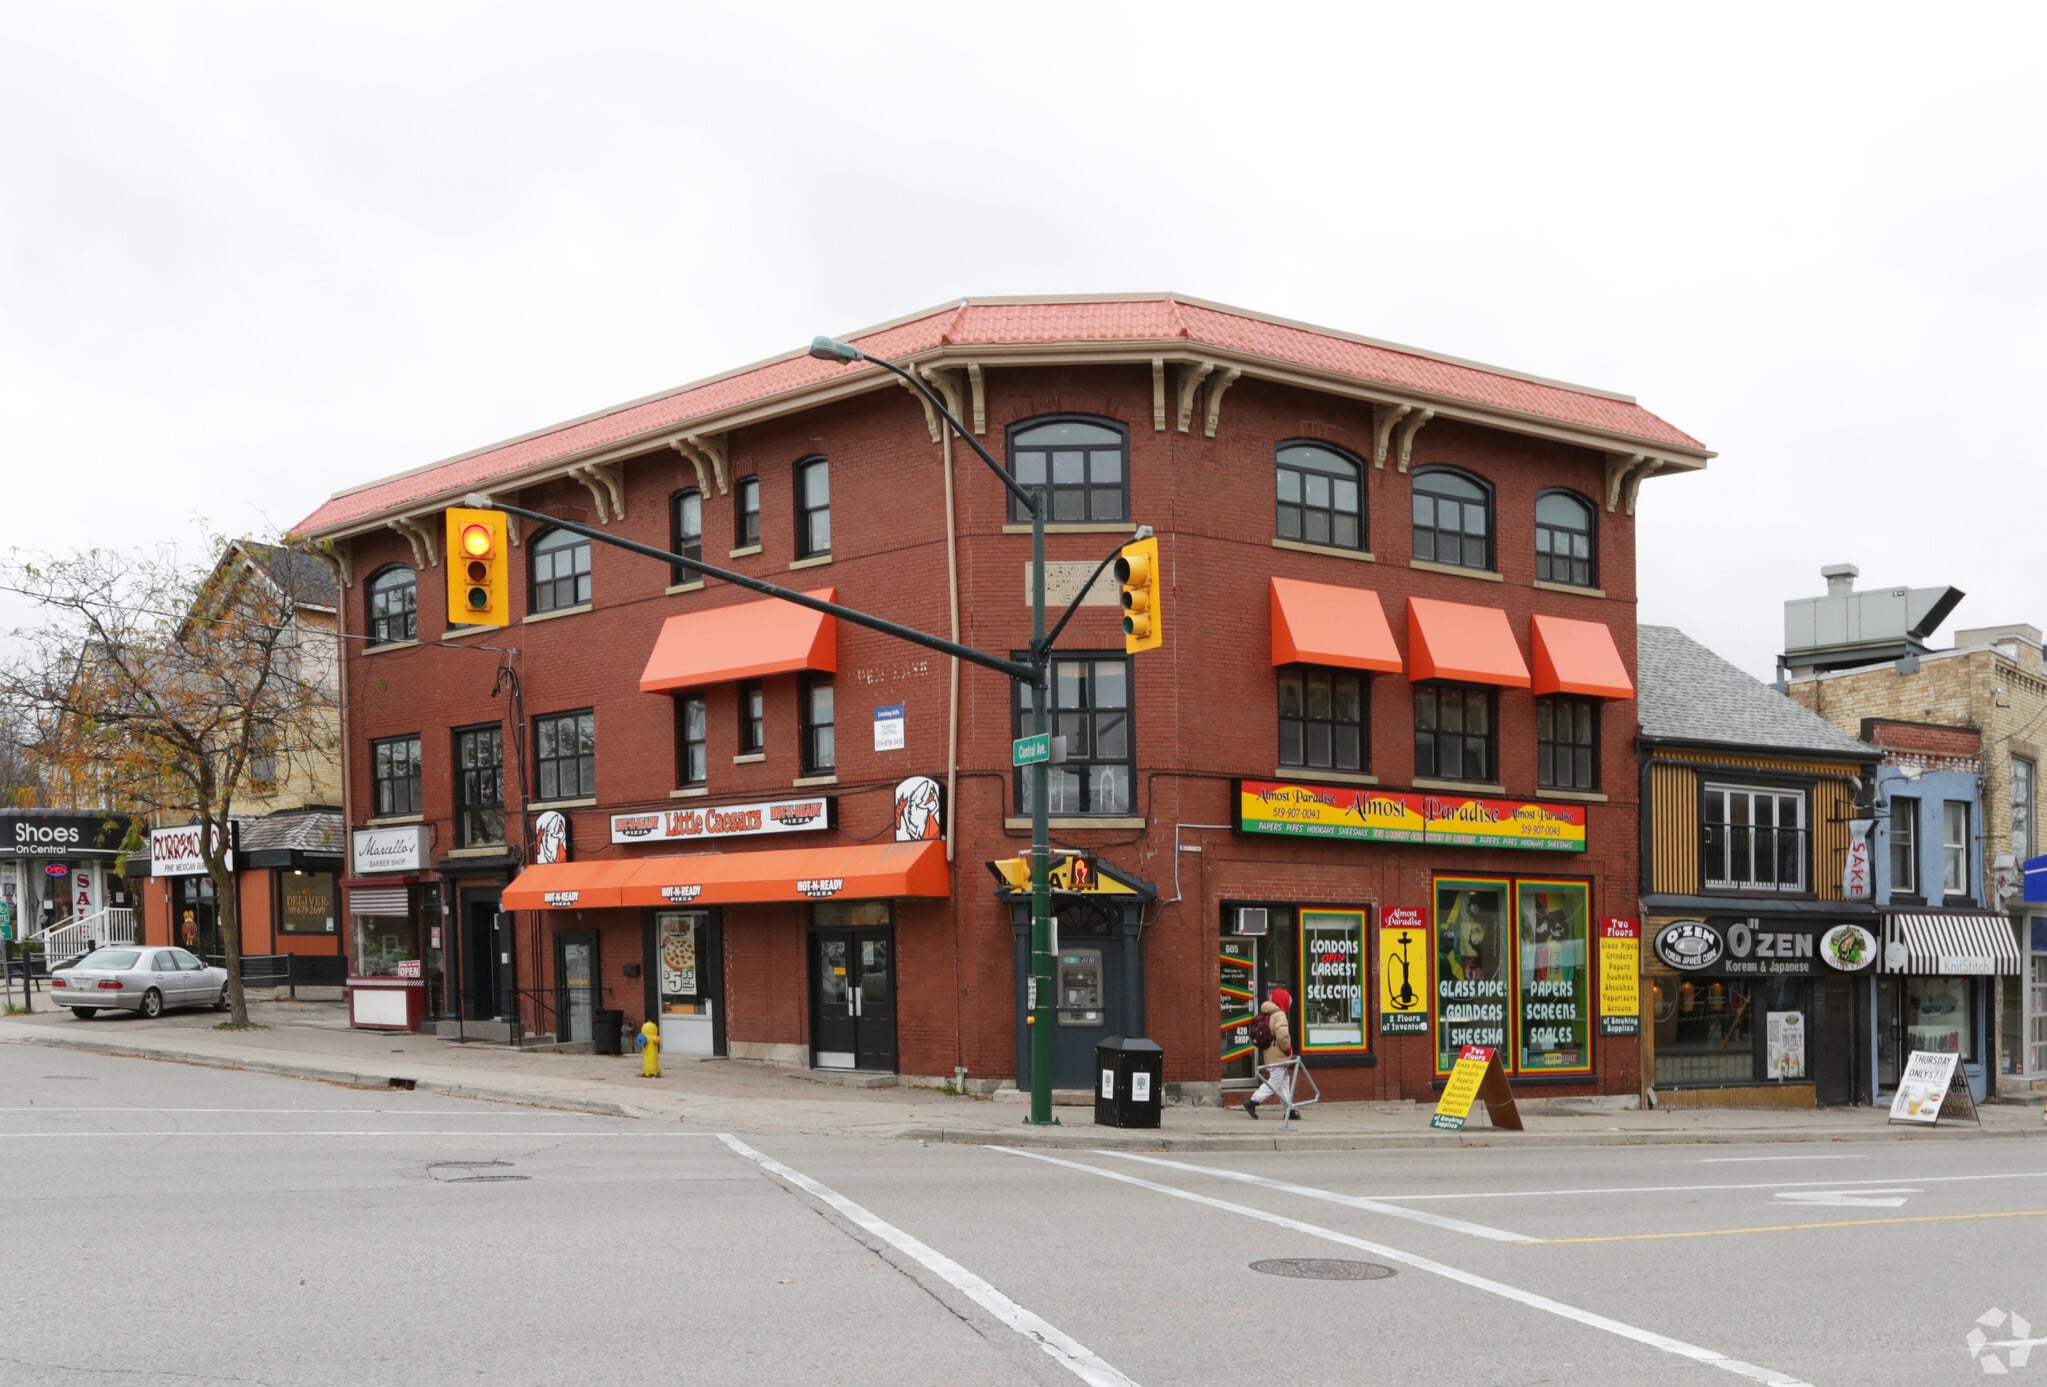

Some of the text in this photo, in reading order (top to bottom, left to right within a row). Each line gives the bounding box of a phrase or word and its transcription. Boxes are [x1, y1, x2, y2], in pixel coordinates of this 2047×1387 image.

[1018, 742, 1047, 759] Central Ave.
[1256, 788, 1336, 807] Almost Paradise
[1273, 807, 1320, 820] 519-907-0043
[1345, 791, 1501, 825] Almost Paradise
[615, 802, 823, 837] HOT-N-READY Little Caesars HOT-N-READY
[782, 817, 811, 825] PIZZA
[1508, 808, 1574, 823] Almost Paradise
[15, 823, 80, 842] Shoes
[1258, 822, 1282, 832] PAPERS
[1286, 823, 1303, 833] PIPES
[1307, 825, 1335, 835] HOOKAHS
[1338, 826, 1369, 837] SHEESHAS
[1479, 836, 1500, 845] PAPERS
[1502, 837, 1518, 846] PIPES
[1547, 840, 1573, 849] SHEESHAS
[16, 845, 66, 854] On Central
[369, 858, 406, 868] BARBER SHOP
[1850, 841, 1866, 896] SAKE
[797, 879, 844, 892] HOT-N-READY
[544, 891, 580, 903] HOT-N-READY
[661, 886, 702, 898] HOT-N-READY
[286, 895, 329, 906] DELIVER
[1391, 908, 1418, 918] Almost
[1385, 917, 1422, 928] Paradise
[1611, 919, 1629, 929] Two
[1607, 927, 1633, 937] Floors
[1225, 944, 1239, 954] 605
[1310, 939, 1359, 954] LONDONS
[1321, 953, 1345, 963] OPEN
[1606, 952, 1633, 960] Grinders
[1665, 947, 1682, 964] KOREAN
[400, 967, 419, 977] OPEN
[1311, 962, 1357, 977] LARGEST
[1609, 963, 1631, 971] Papers
[1725, 959, 1758, 973] Korean
[1760, 960, 1766, 973] &
[1769, 959, 1809, 974] Japanese
[1439, 980, 1476, 998] GLASS
[1530, 980, 1573, 997] PAPERS
[1446, 1003, 1503, 1021] GRINDERS
[1526, 1003, 1576, 1021] SCREENS
[1397, 1014, 1421, 1023] Floors
[1603, 1017, 1638, 1026] of Smoking
[1236, 1026, 1248, 1036] 420
[1382, 1022, 1425, 1031] of Inventor
[1607, 1024, 1634, 1034] Supplies
[1234, 1035, 1250, 1044] SHOP
[1451, 1027, 1503, 1046] SHEESHA
[1531, 1026, 1573, 1043] SCALES
[1471, 1046, 1485, 1055] Two
[1464, 1053, 1486, 1061] Floors
[1914, 1054, 1952, 1066] THURSDAY
[1909, 1069, 1930, 1078] ONLY
